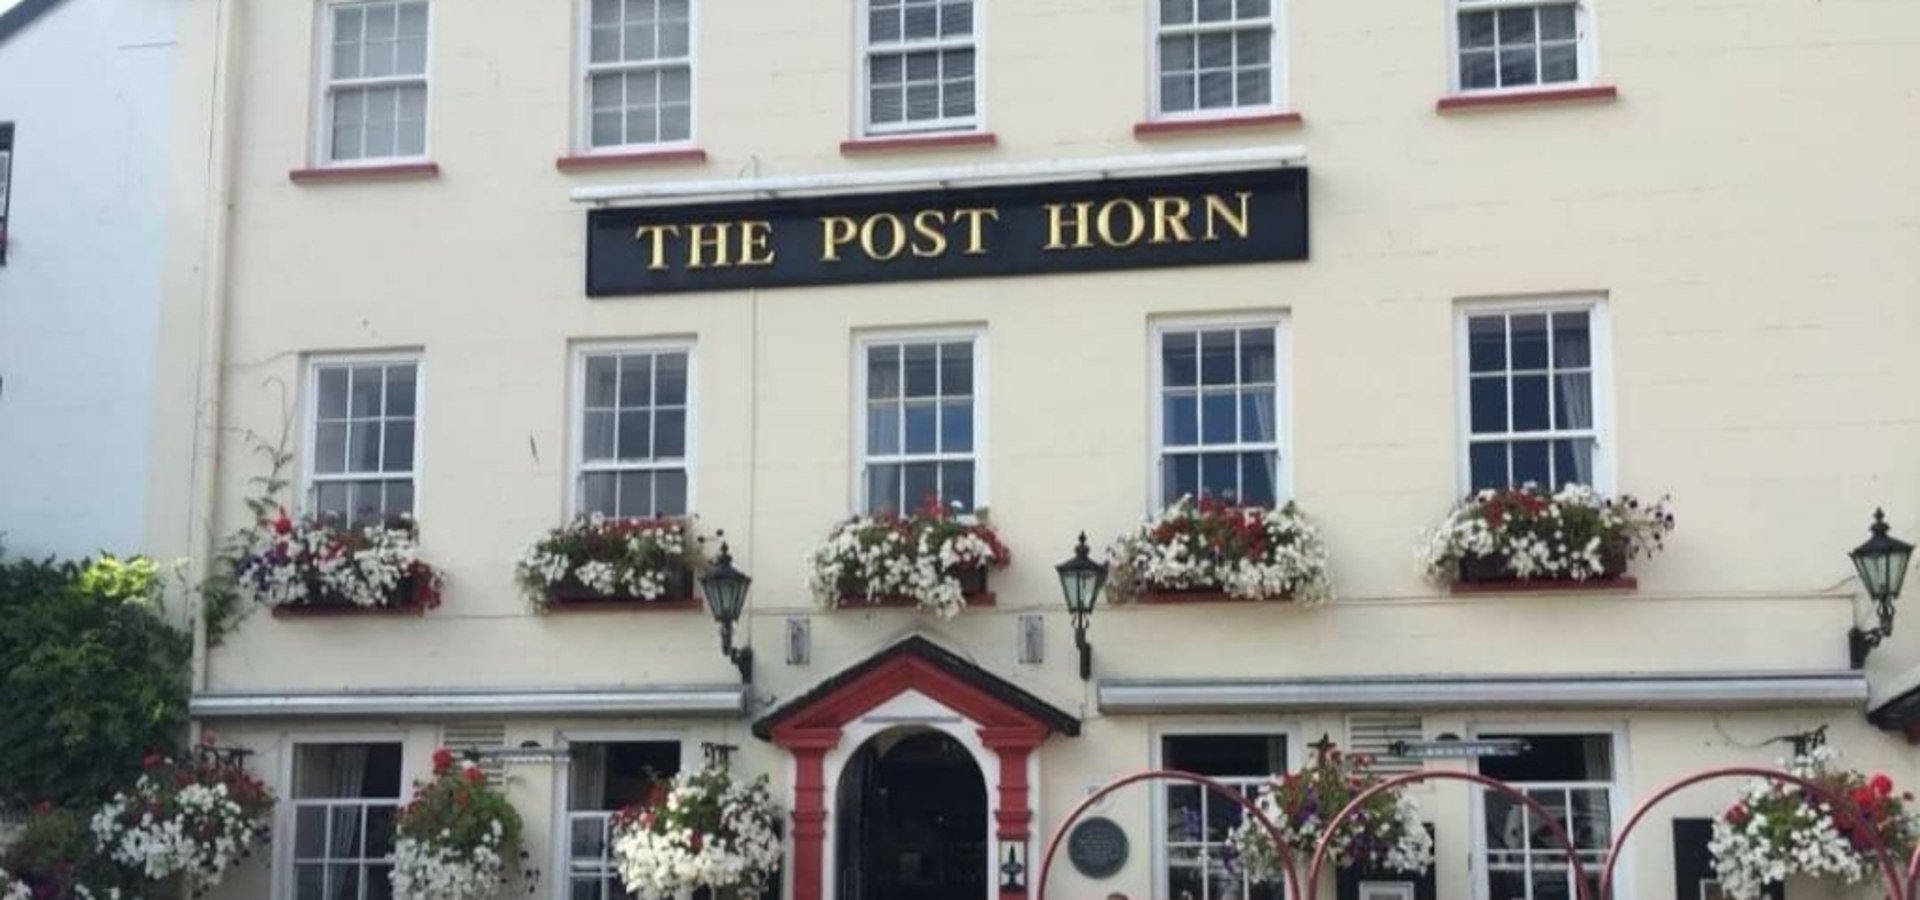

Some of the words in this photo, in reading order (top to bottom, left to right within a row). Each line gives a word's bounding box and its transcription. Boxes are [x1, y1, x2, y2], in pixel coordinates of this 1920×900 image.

[636, 220, 775, 270] THE
[819, 207, 998, 262] POST
[1042, 191, 1253, 251] HORN
